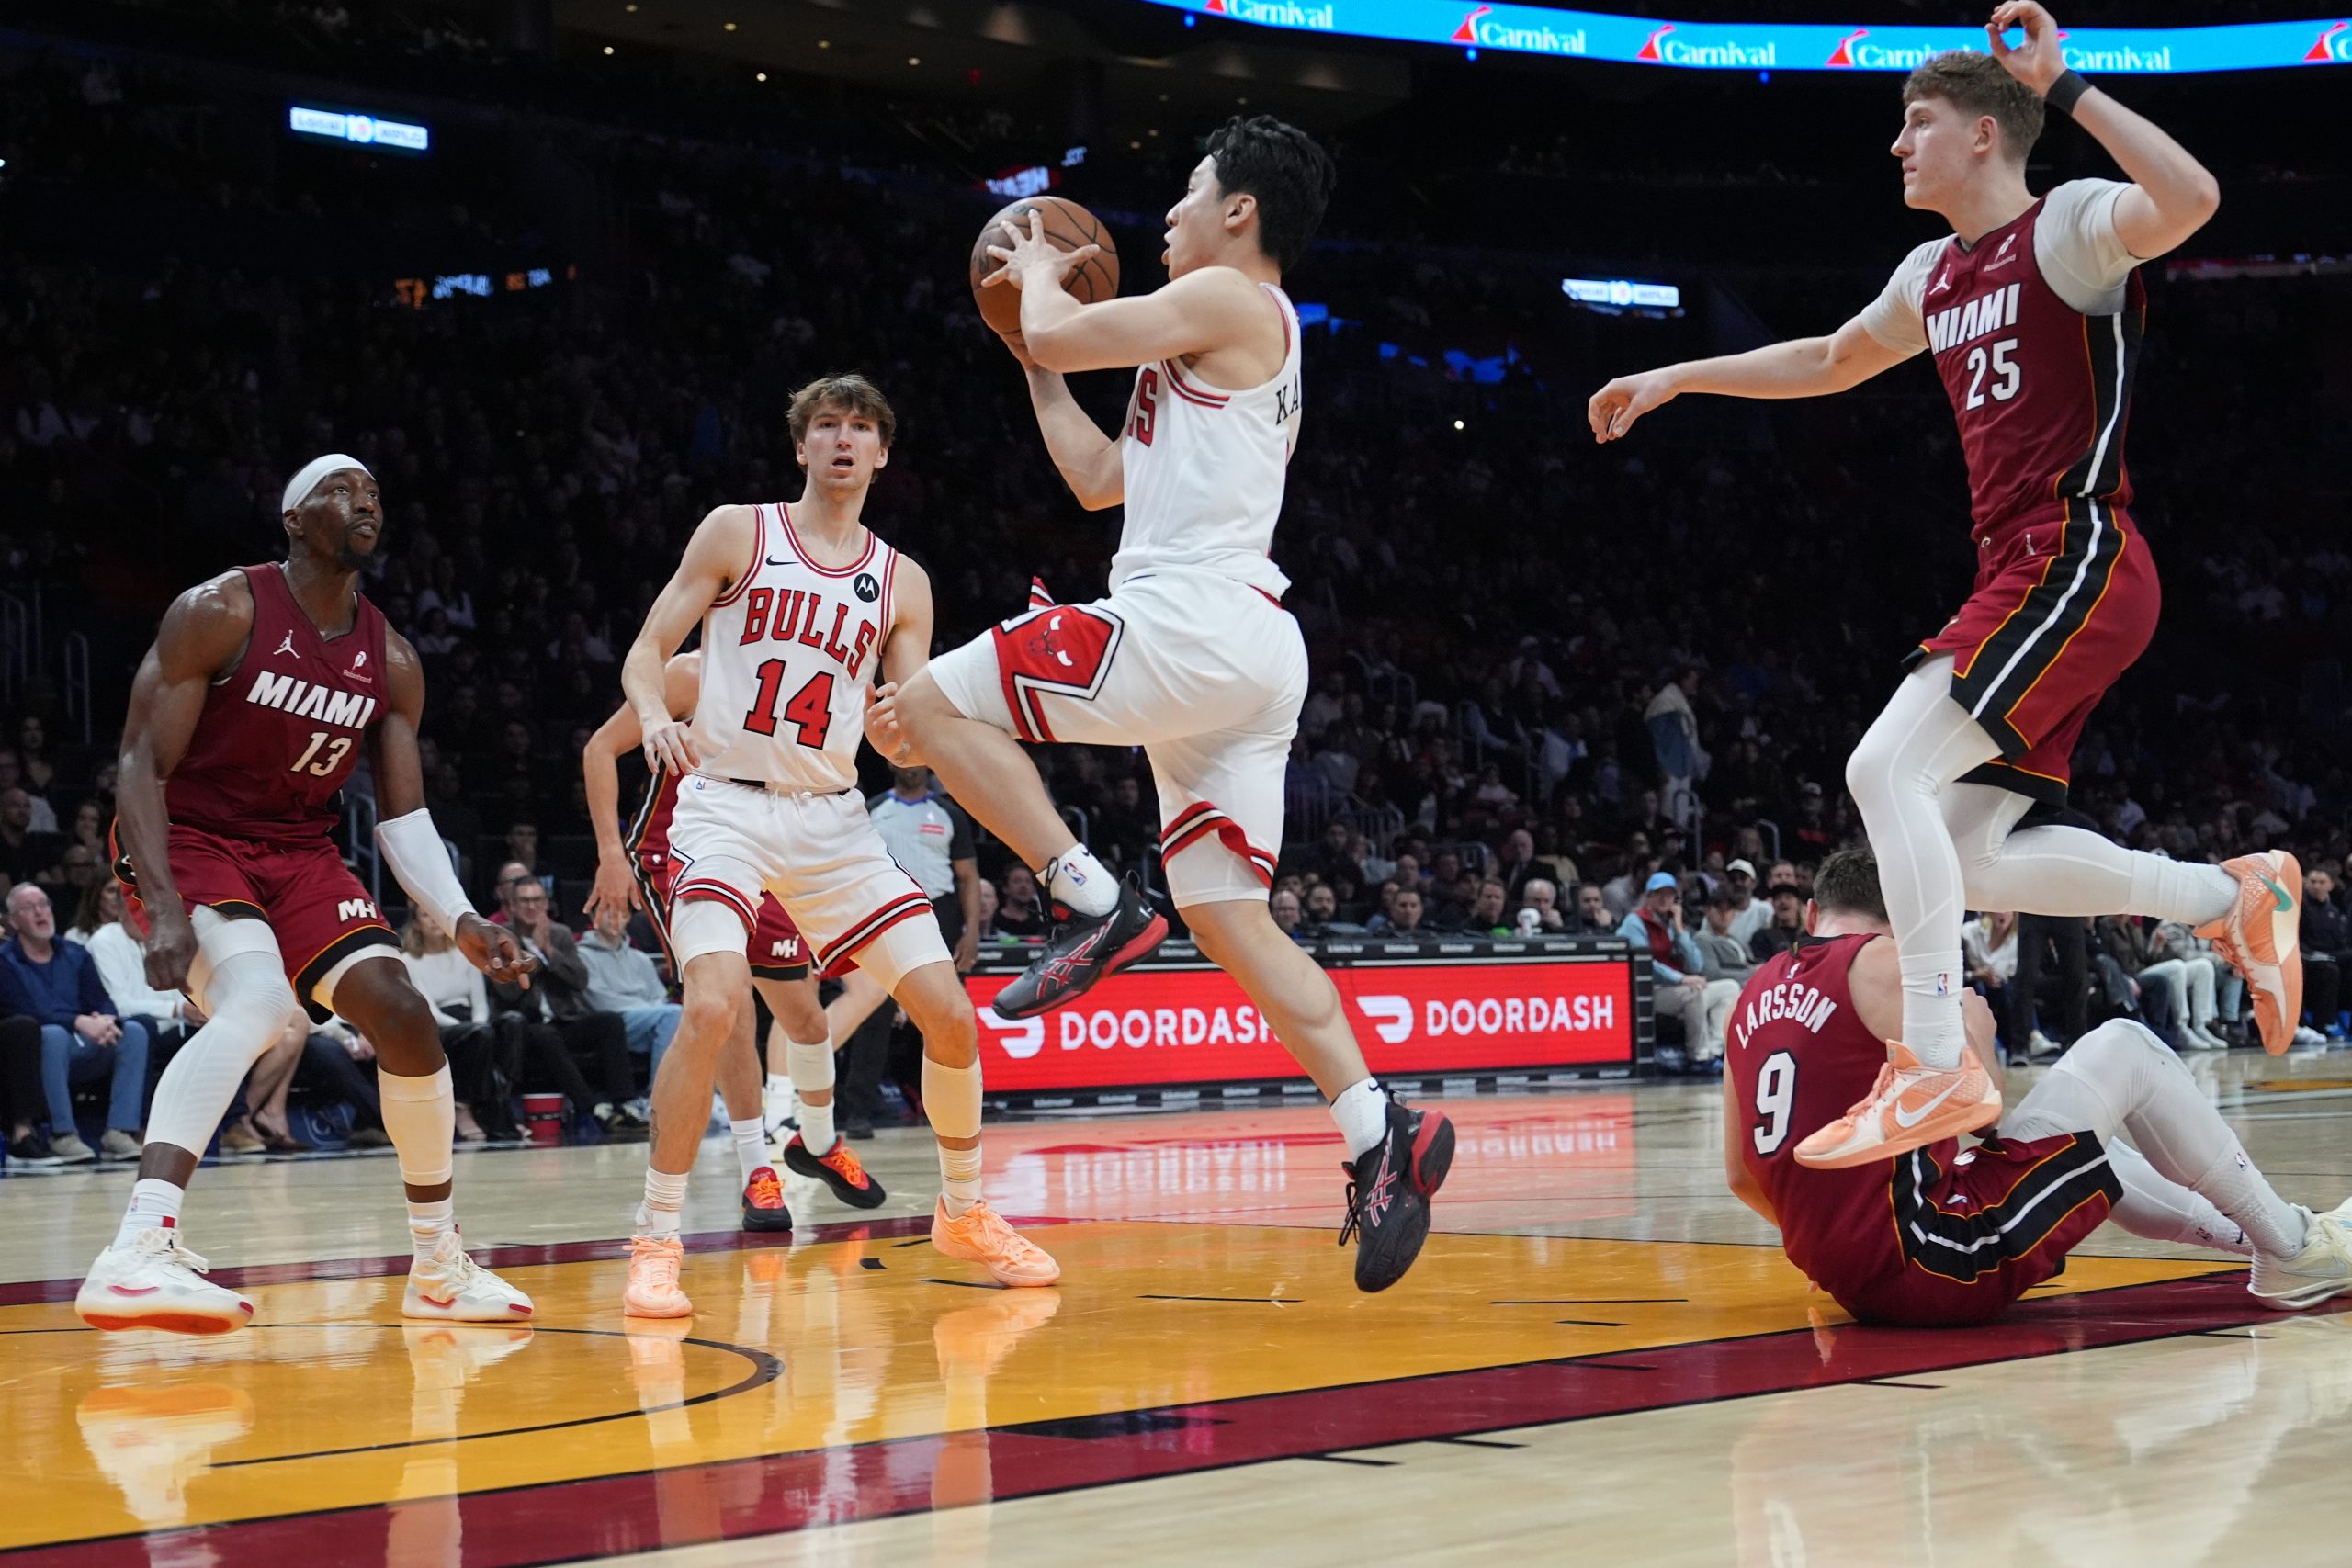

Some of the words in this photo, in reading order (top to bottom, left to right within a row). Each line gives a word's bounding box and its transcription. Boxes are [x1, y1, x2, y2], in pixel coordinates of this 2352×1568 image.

[1228, 0, 1333, 29] Carnival
[1480, 21, 1586, 54] Carnival
[1664, 40, 1776, 66] Carnival
[2062, 45, 2171, 70] Carnival
[1927, 283, 2021, 355] MIAMI
[1966, 338, 2021, 411] 25
[740, 587, 877, 681] BULLS
[246, 671, 376, 729] MIAMI
[743, 658, 835, 750] 14
[290, 732, 352, 777] 13
[1426, 995, 1613, 1036] DOORDASH
[1736, 983, 1838, 1050] LARSSON
[1754, 1052, 1796, 1155] 9
